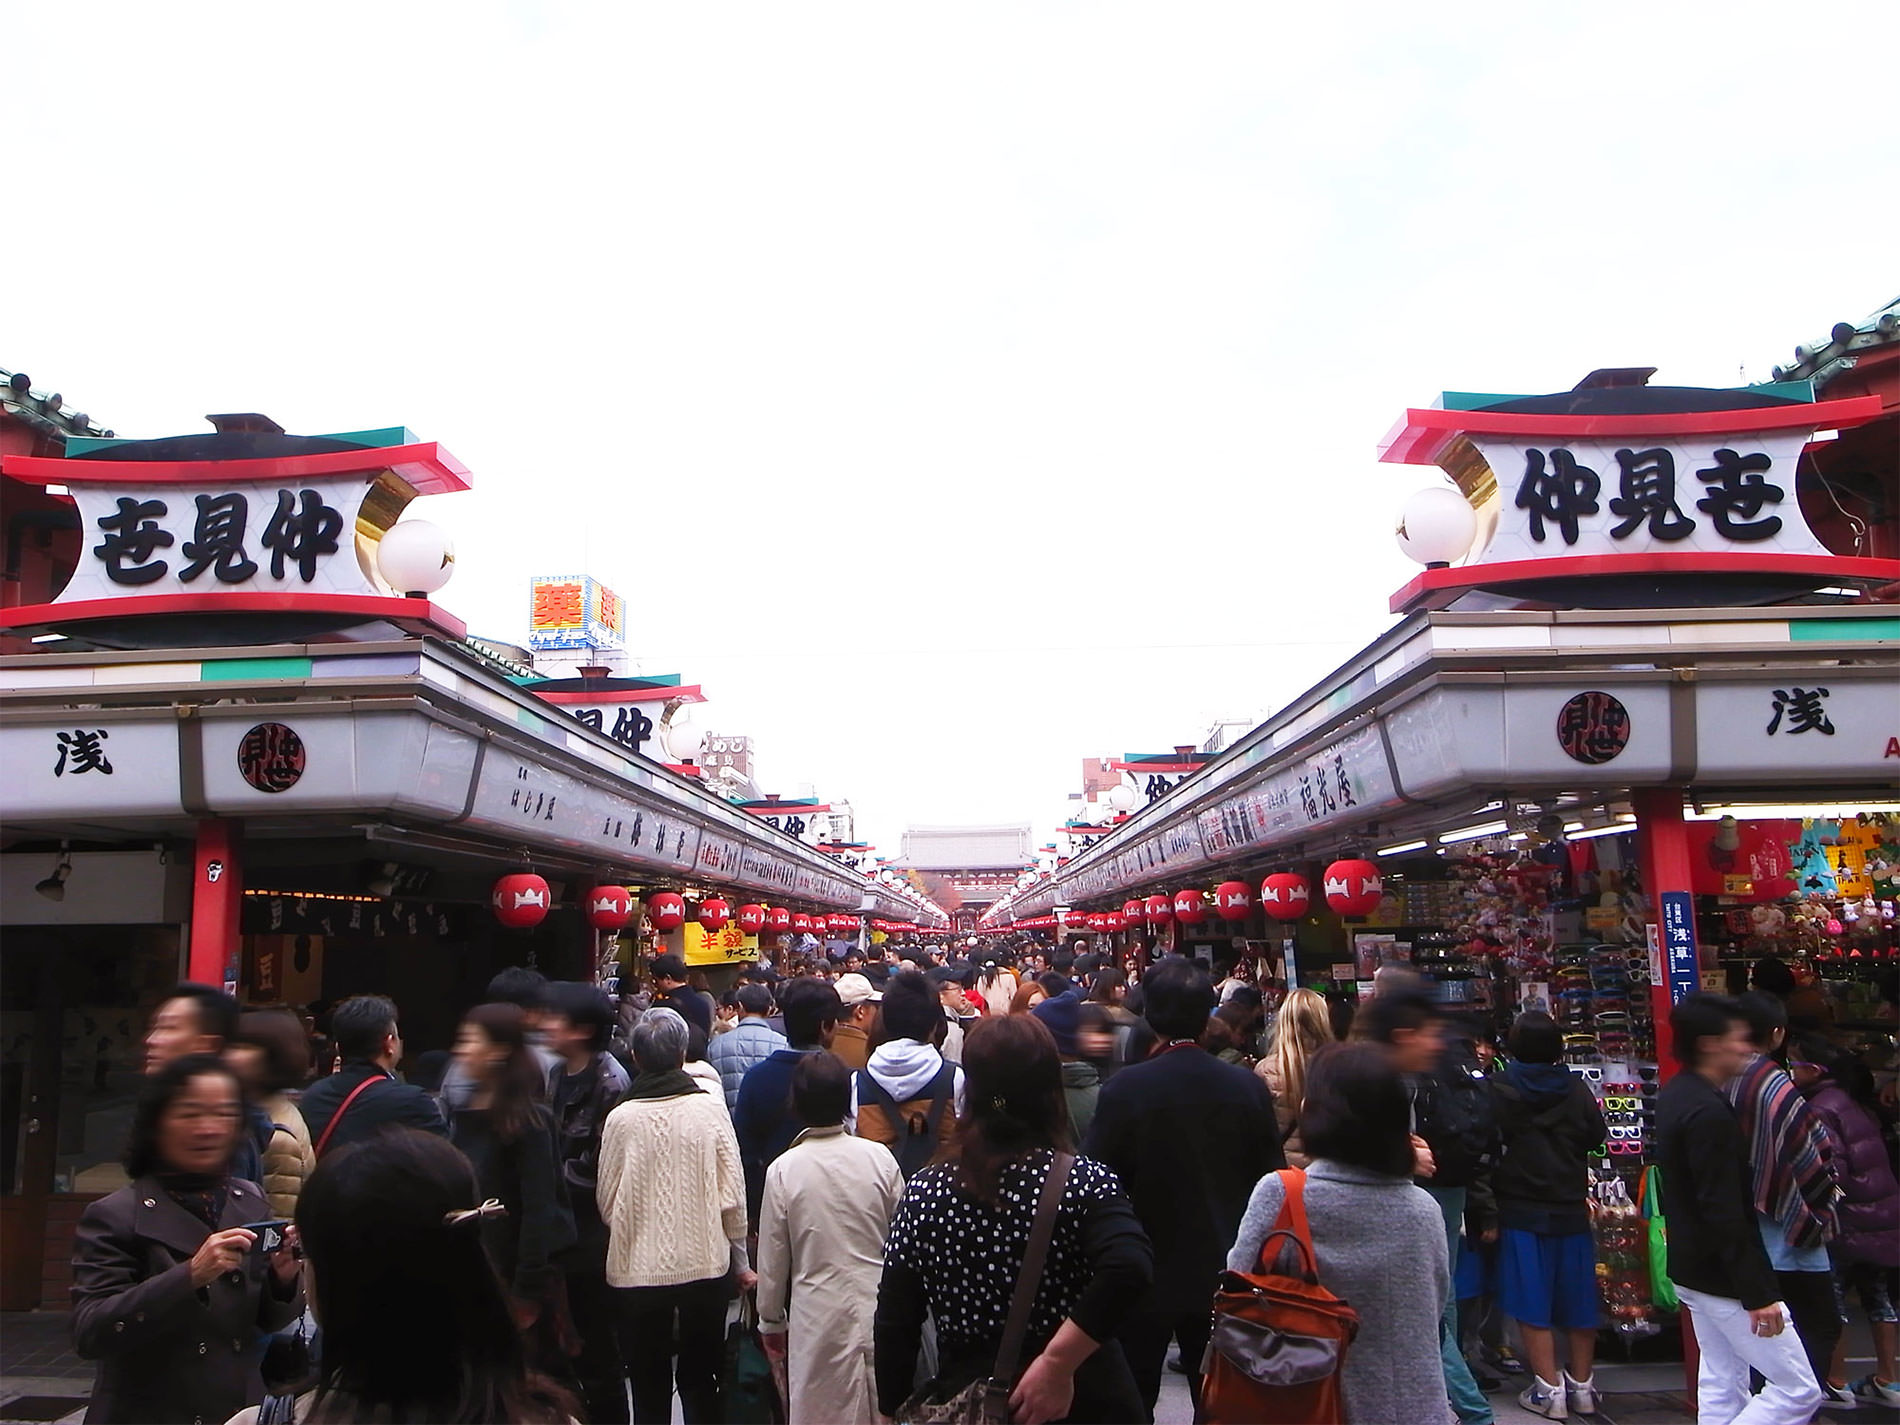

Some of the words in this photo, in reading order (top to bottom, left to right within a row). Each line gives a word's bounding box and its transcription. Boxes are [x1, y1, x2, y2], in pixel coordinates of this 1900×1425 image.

[534, 583, 582, 627] 薬
[1767, 687, 1835, 736] 浅
[54, 729, 113, 777] 浅
[1300, 754, 1357, 822] 福光屋
[701, 930, 743, 950] 半額
[725, 947, 758, 959] サービス
